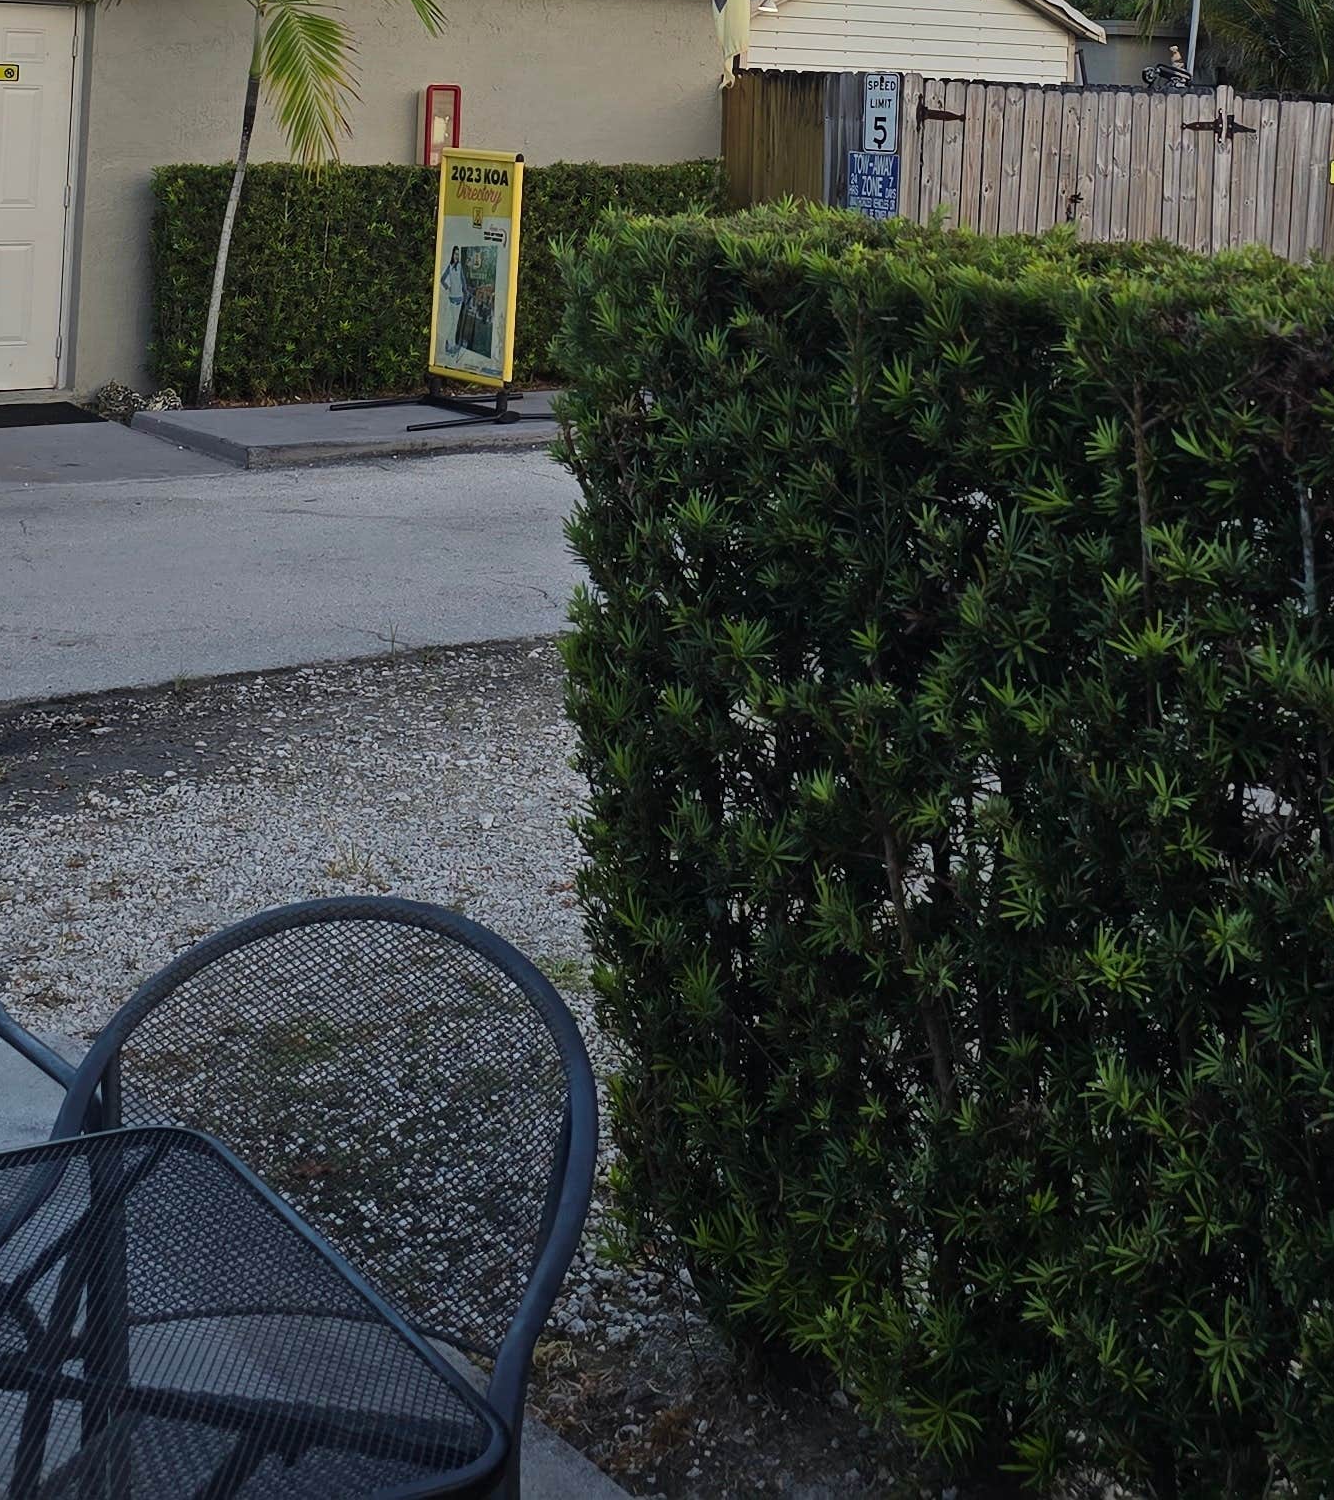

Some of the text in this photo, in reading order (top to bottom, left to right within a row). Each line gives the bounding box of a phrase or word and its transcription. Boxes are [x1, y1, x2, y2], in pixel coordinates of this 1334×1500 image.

[867, 80, 896, 91] SPEED
[870, 98, 892, 108] LIMIT
[873, 116, 887, 145] 5
[853, 153, 894, 176] TOW-AWAY
[451, 165, 509, 187] 2023 KOA
[850, 172, 858, 184] 24
[861, 175, 884, 197] ZONE
[888, 176, 894, 187] 7
[456, 181, 503, 213] Directory
